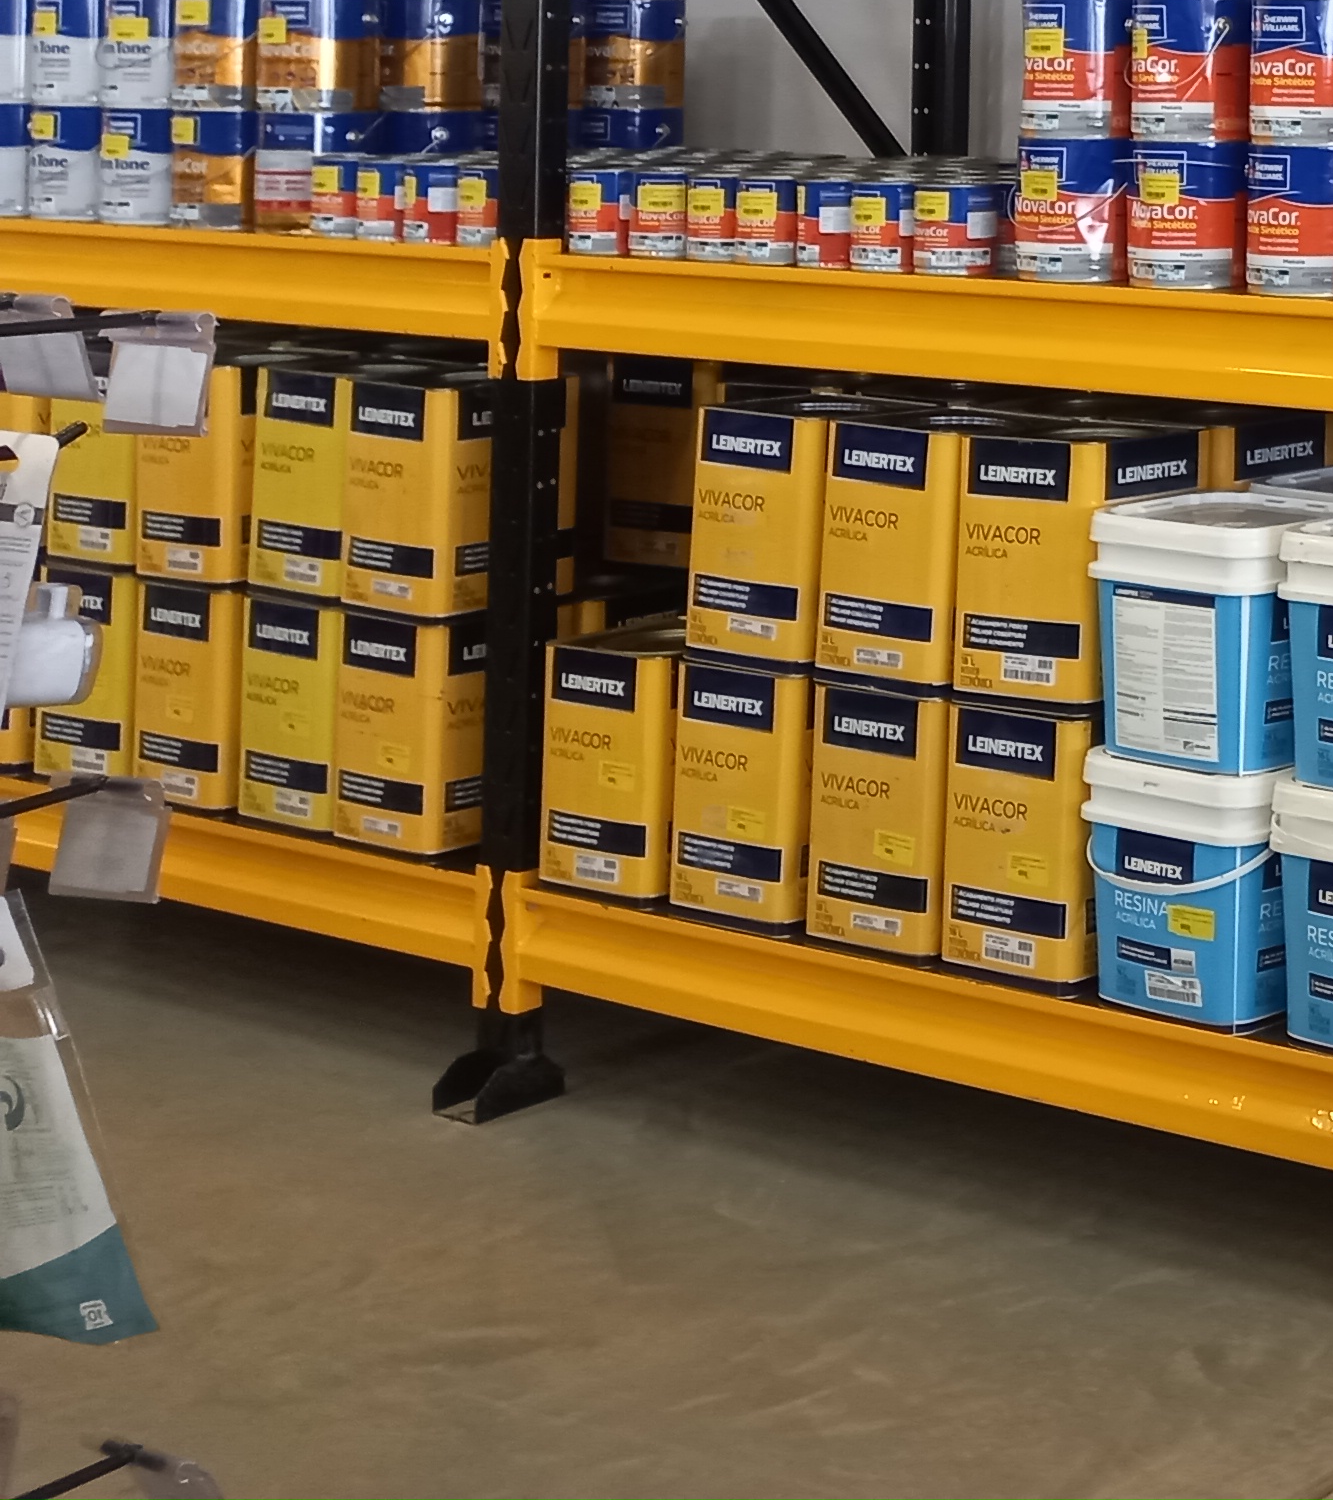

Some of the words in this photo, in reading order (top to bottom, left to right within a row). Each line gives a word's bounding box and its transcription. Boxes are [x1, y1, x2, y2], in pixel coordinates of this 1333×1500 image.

[272, 393, 327, 414] LEINERTEX
[359, 406, 415, 428] LEINERTEX
[844, 449, 914, 472] LEINERTEX
[1118, 459, 1187, 485] LEINERTEX
[980, 465, 1056, 486] LEINERTEX
[966, 524, 1040, 546] VIVACOR
[351, 639, 406, 662] LEINERTEX
[562, 674, 624, 696] LEINERTEX
[694, 692, 762, 716] LEINERTEX
[968, 736, 1043, 761] LEINERTEX
[954, 794, 1028, 820] VIVACOR
